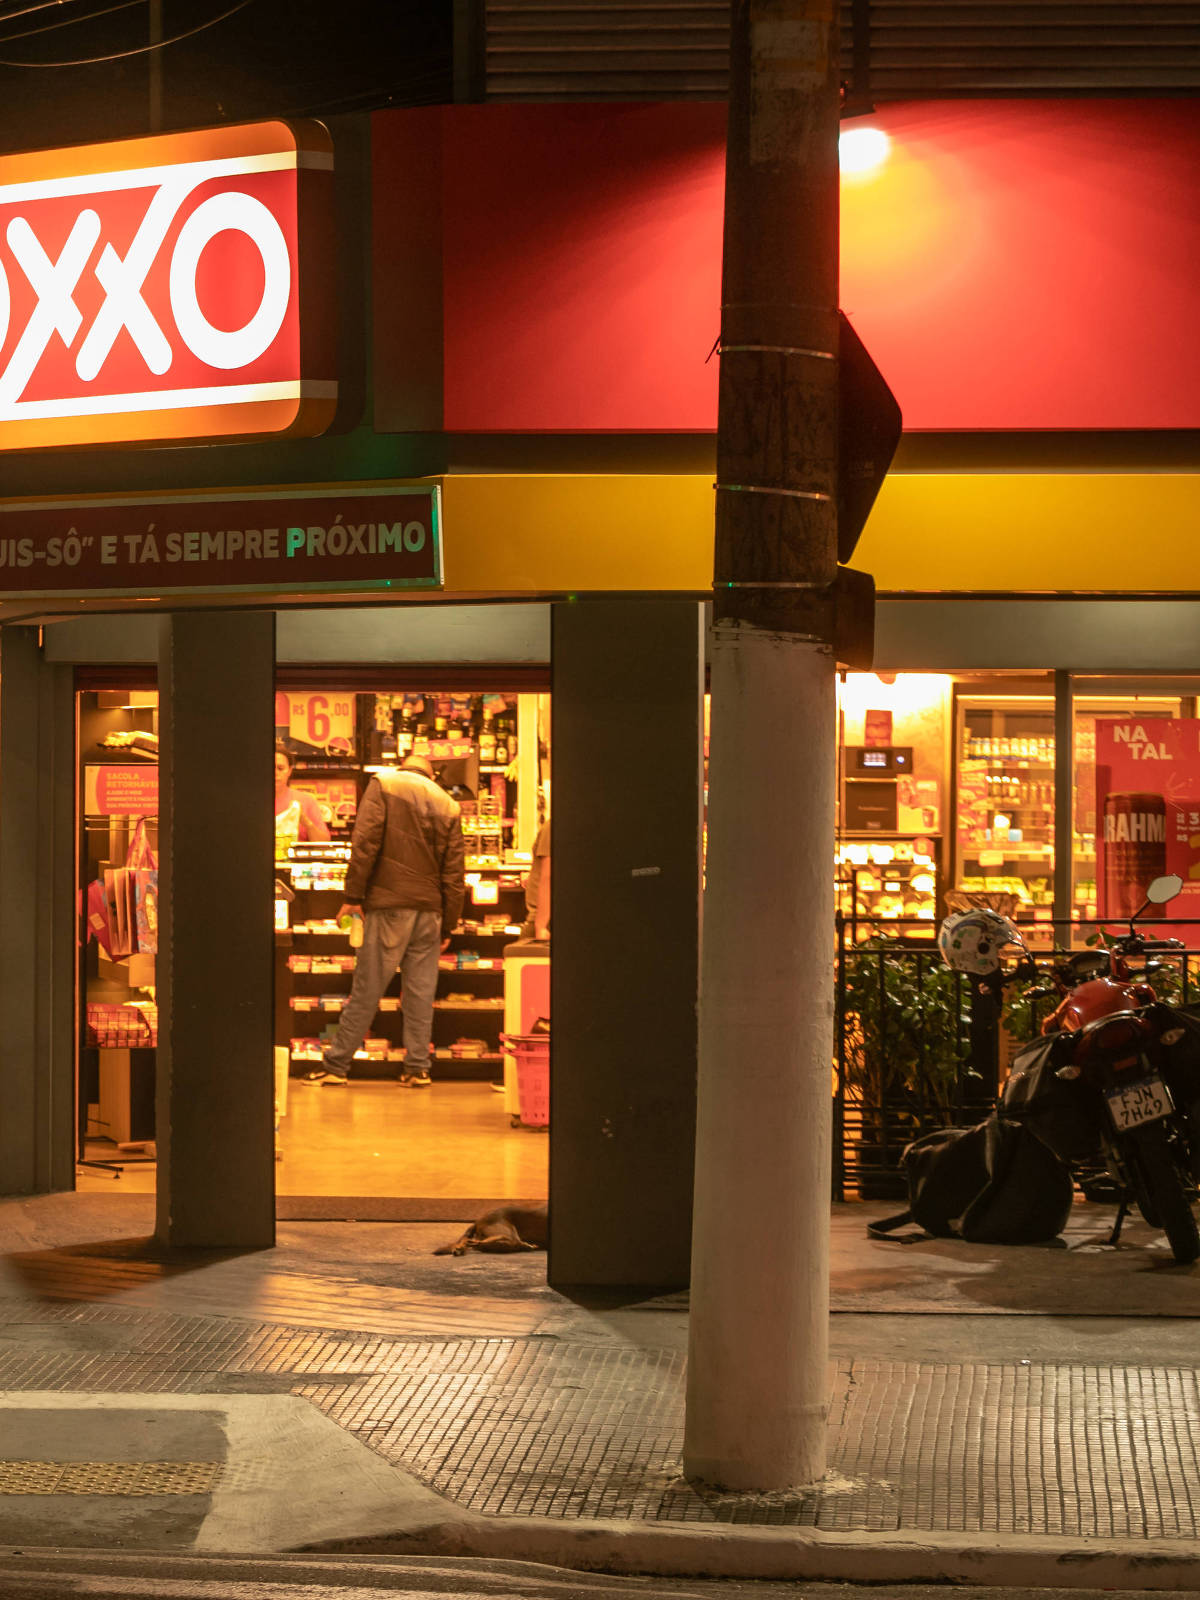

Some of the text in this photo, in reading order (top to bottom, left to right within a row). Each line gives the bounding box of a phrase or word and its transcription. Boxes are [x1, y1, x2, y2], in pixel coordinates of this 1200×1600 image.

[100, 535, 117, 564] E
[124, 524, 160, 563] TÁ
[166, 528, 280, 562] SEMPRE
[287, 514, 426, 557] PRÓXIMO
[1113, 725, 1149, 743] NA
[1128, 742, 1174, 761] TAL
[1104, 812, 1166, 843] RAHM
